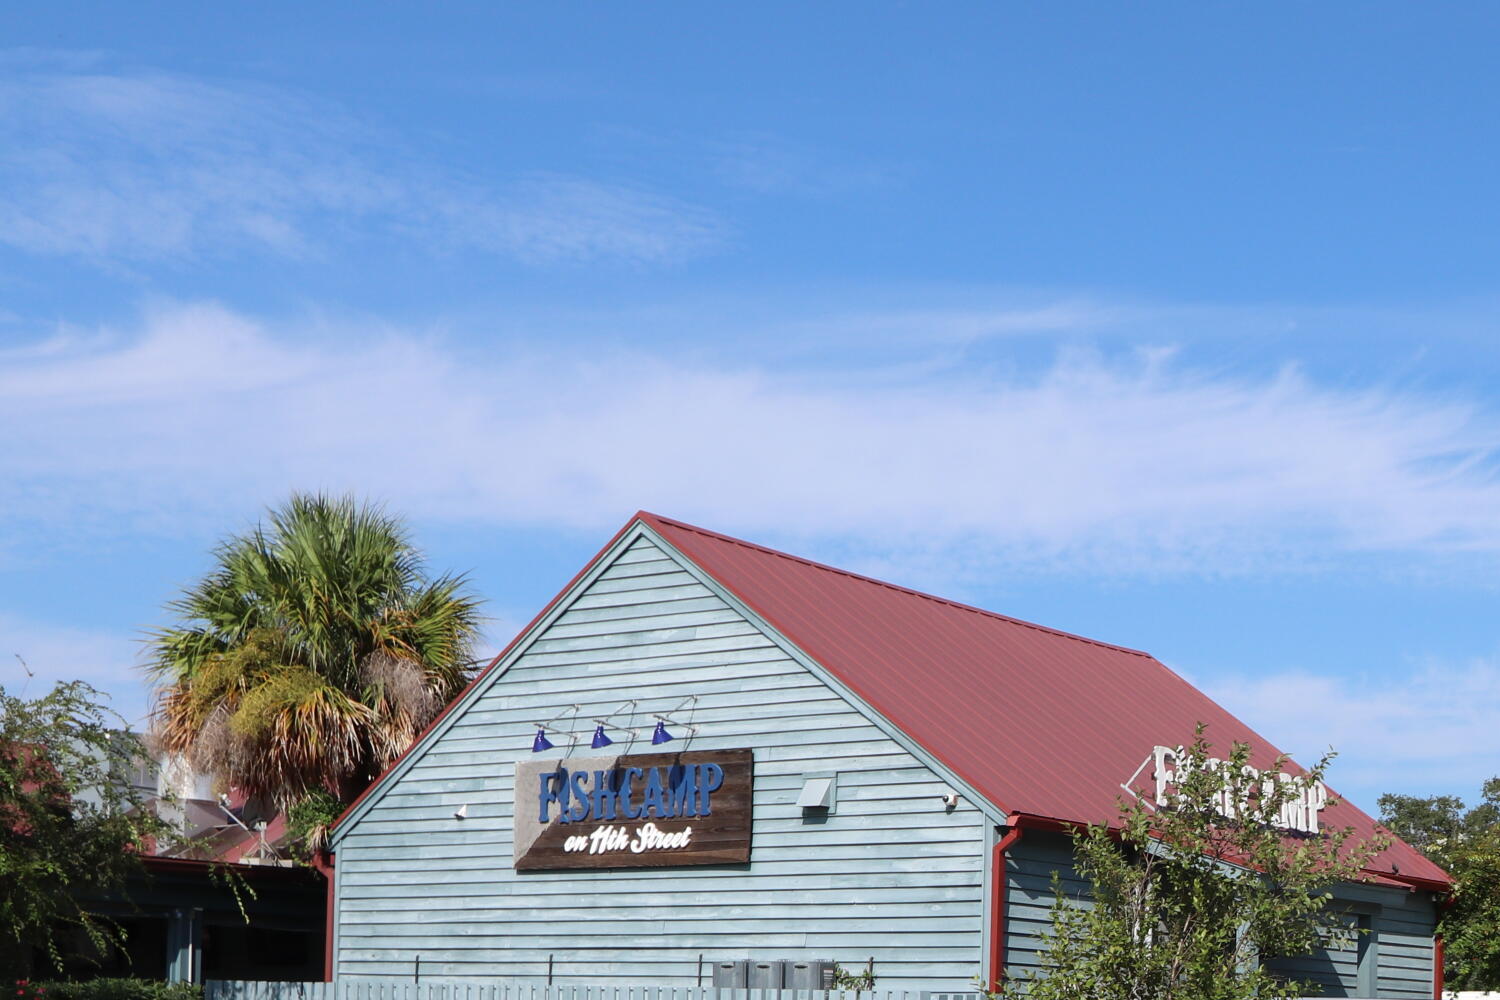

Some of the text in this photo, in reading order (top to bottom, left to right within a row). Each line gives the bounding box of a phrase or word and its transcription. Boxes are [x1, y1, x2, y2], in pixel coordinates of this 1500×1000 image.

[563, 821, 692, 855] on 11th Street
